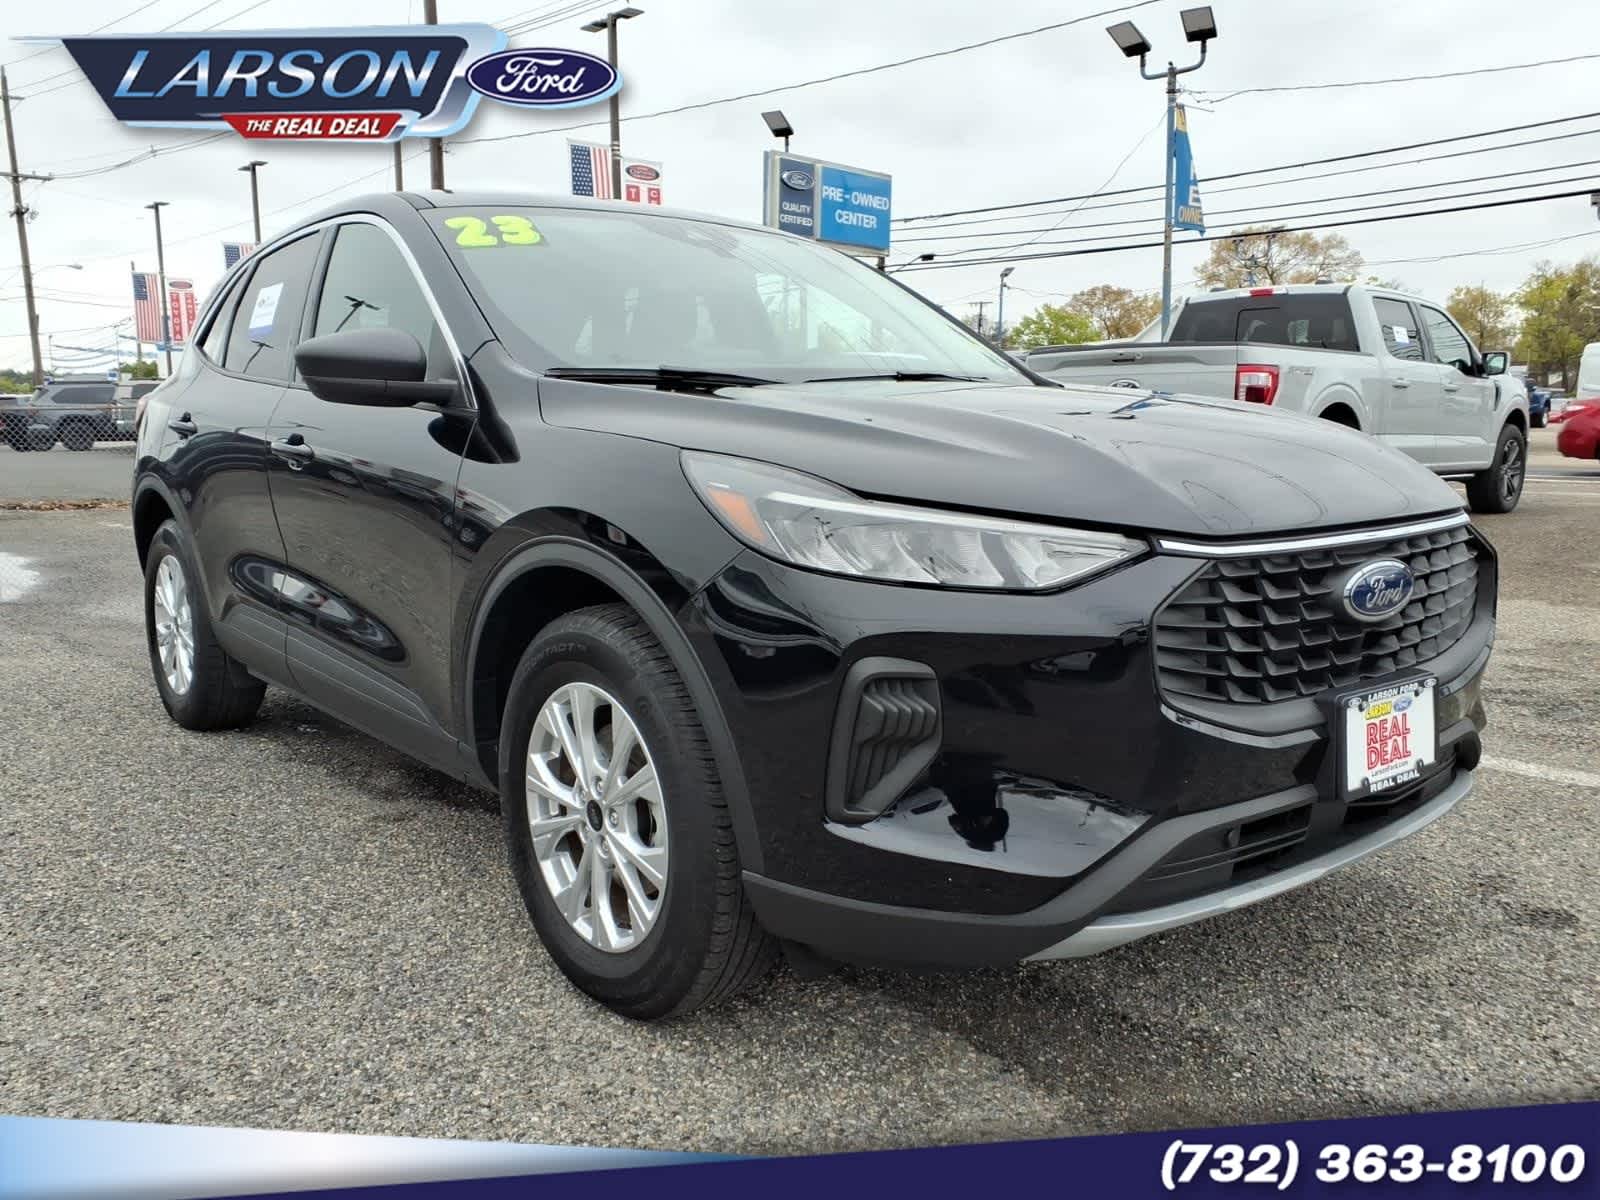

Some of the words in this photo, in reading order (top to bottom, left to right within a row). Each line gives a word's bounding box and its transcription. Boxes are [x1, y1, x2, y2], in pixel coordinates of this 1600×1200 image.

[782, 201, 811, 215] QUALITY
[822, 185, 889, 210] PRE-OWNED
[444, 215, 541, 247] 23
[779, 214, 813, 227] CERTIFIED
[834, 209, 878, 229] CENTER
[1366, 575, 1405, 608] Ford
[1367, 688, 1399, 703] LARSON
[1366, 713, 1411, 746] REAL
[1367, 735, 1412, 770] DEAL
[1370, 778, 1395, 793] REAL
[1396, 769, 1420, 785] DEAL
